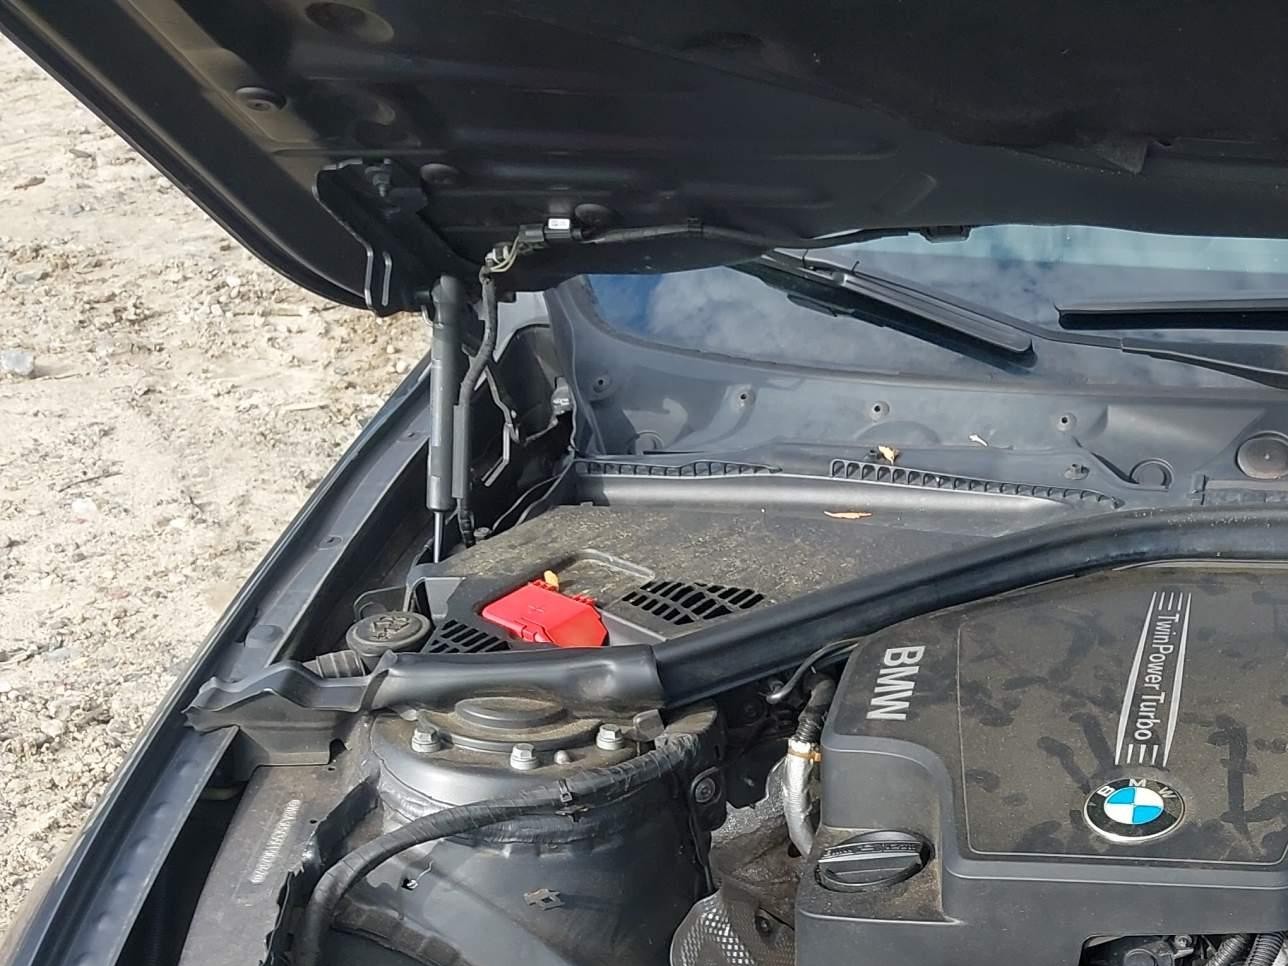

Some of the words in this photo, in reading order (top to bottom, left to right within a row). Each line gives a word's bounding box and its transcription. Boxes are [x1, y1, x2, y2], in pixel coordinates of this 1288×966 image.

[866, 645, 926, 721] BMW
[1144, 613, 1180, 691] TwinPower
[1135, 691, 1167, 741] Turbo
[1096, 777, 1177, 801] BMW
